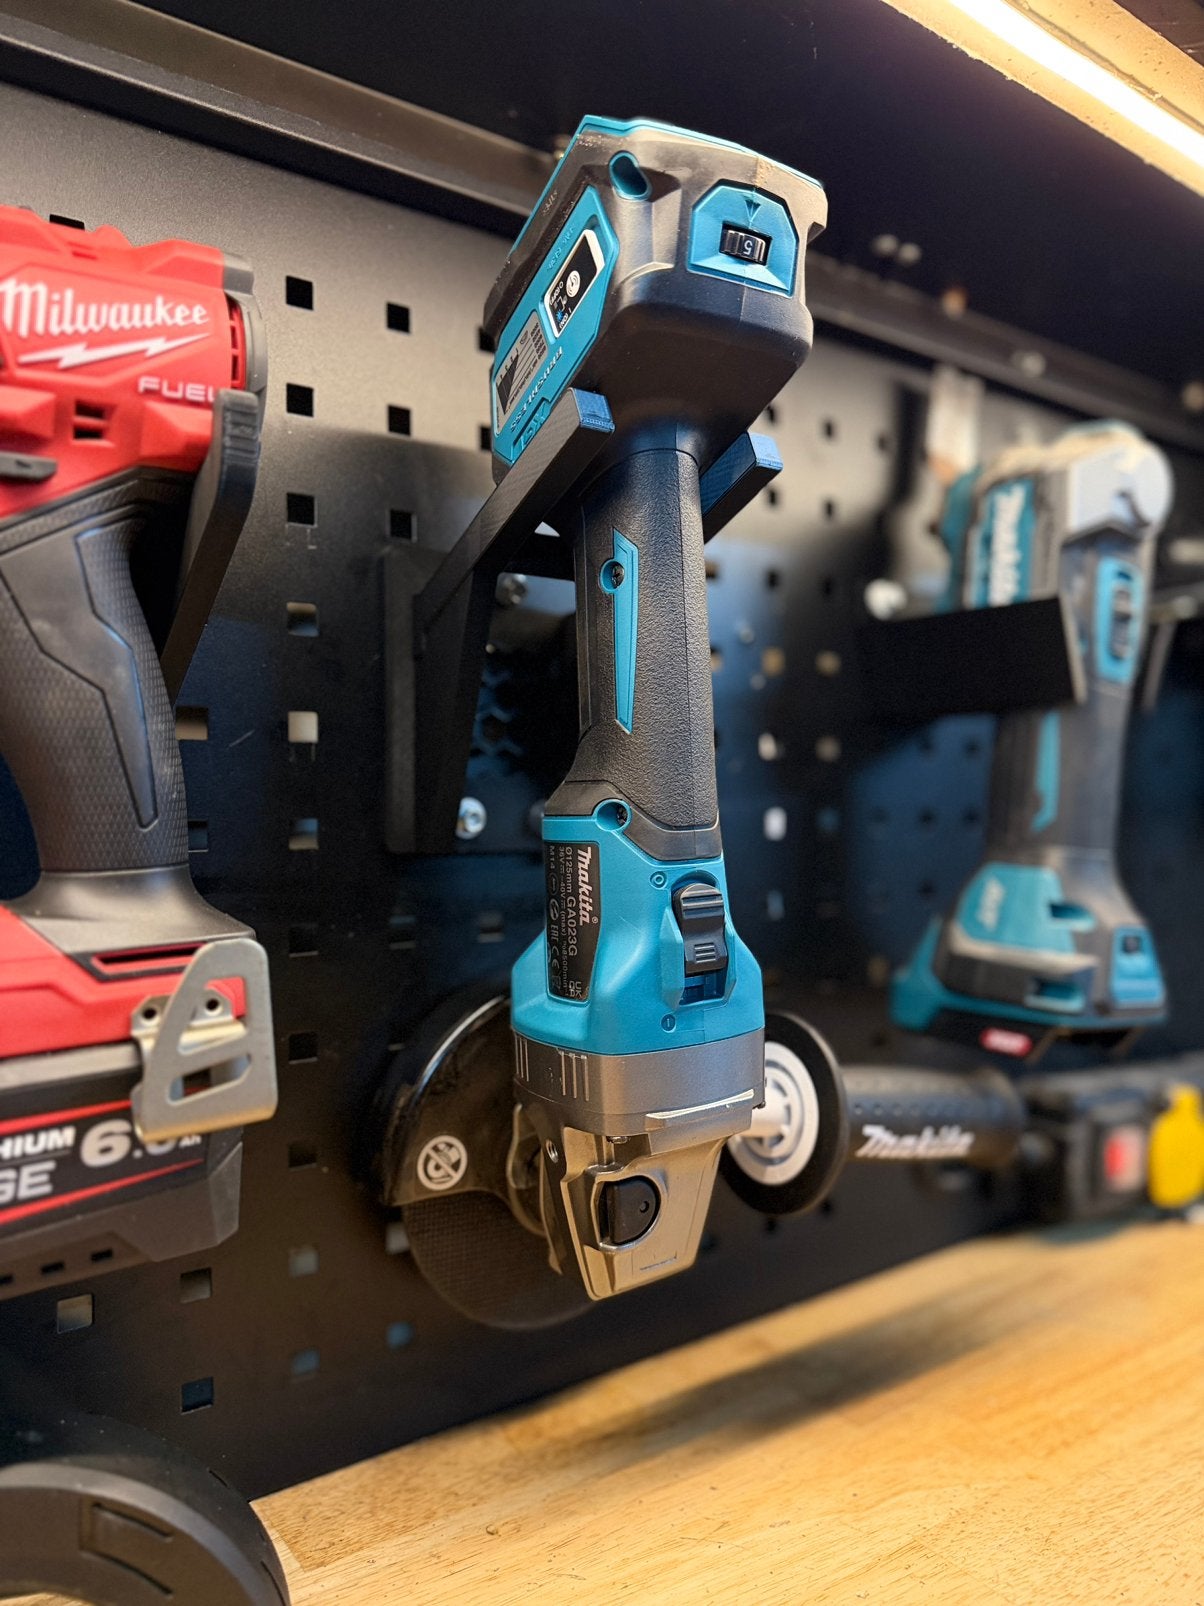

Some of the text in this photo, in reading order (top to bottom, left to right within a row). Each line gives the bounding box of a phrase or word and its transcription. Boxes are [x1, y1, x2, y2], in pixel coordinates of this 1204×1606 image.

[743, 240, 753, 255] 5
[0, 278, 209, 339] Milwaukee
[566, 895, 578, 956] GA023G
